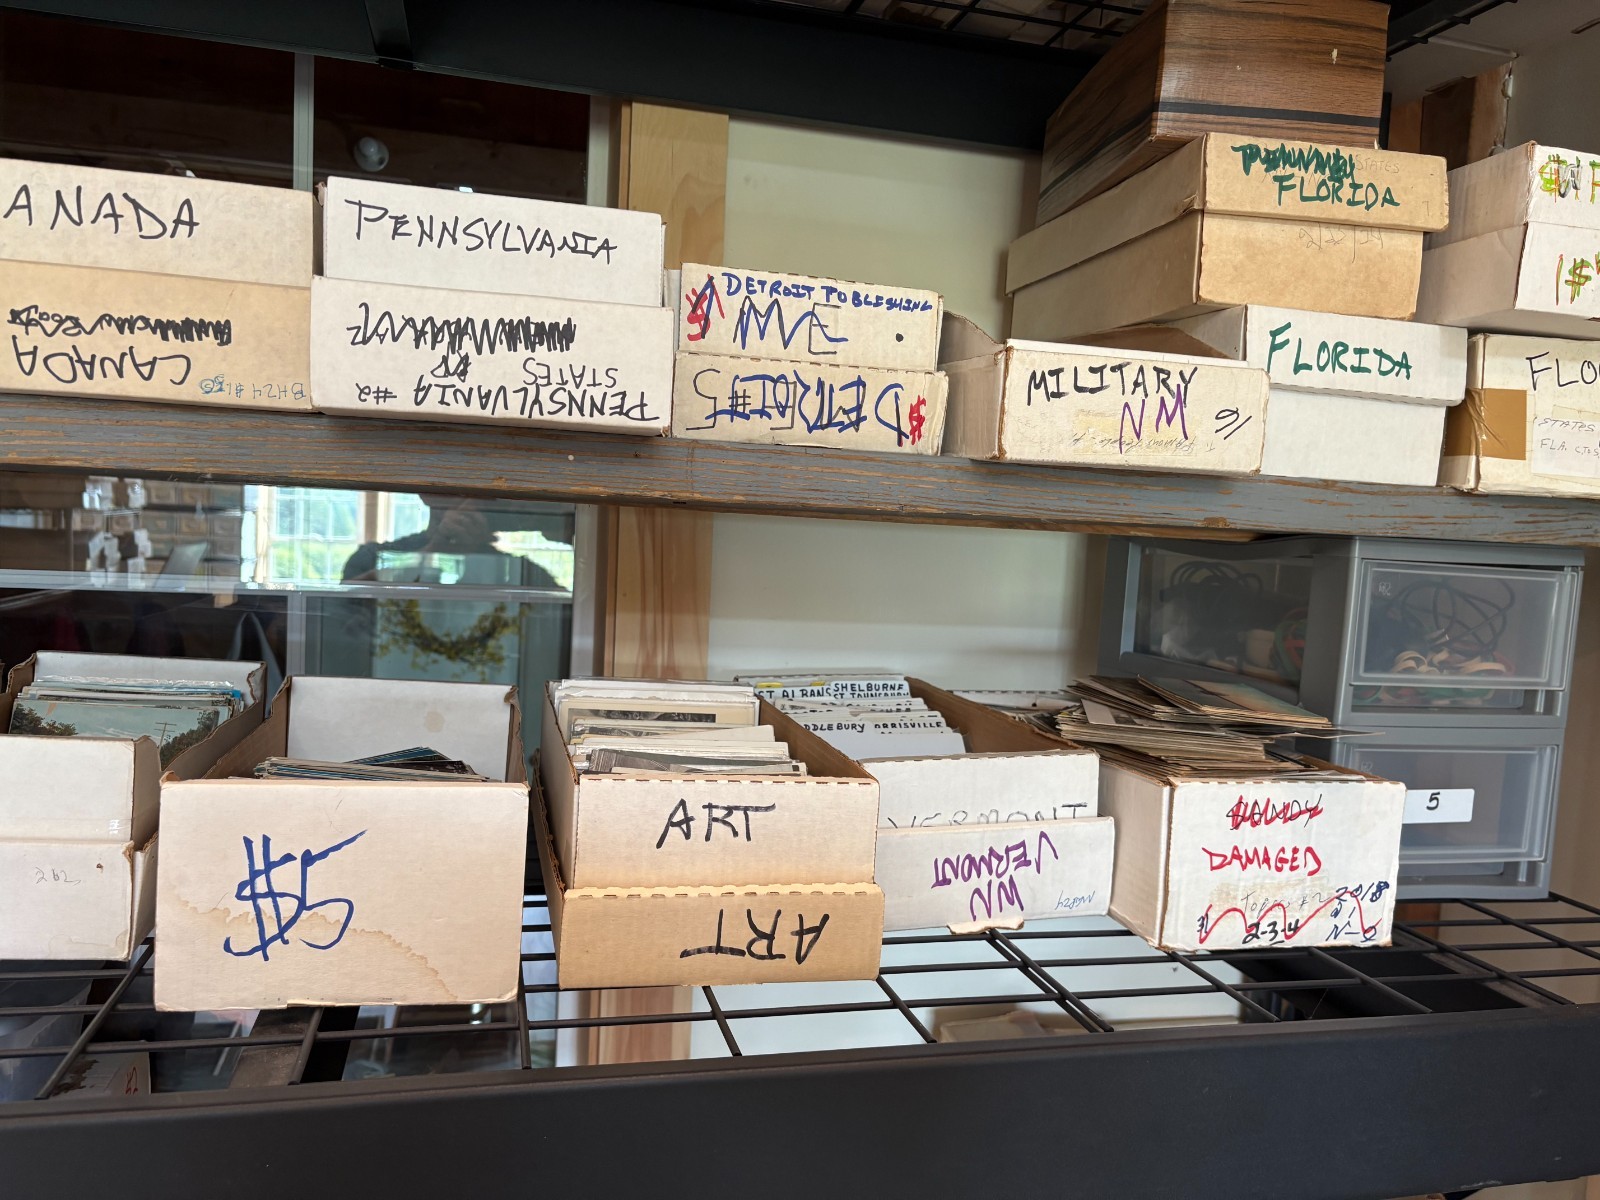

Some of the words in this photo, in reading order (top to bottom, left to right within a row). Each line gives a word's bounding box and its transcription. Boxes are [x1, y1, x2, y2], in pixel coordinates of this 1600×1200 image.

[3, 184, 200, 239] ANADA
[1272, 173, 1400, 212] FLORIDA
[345, 199, 617, 264] PENNSYLVANIA
[722, 272, 815, 301] DETROIT
[12, 335, 191, 386] CANADA
[522, 357, 618, 388] STATES
[1267, 322, 1412, 380] FLORIDA
[414, 375, 660, 421] PENNSYLVANIA
[1027, 361, 1198, 408] MILITARY
[832, 683, 905, 693] SHELBURNE
[655, 798, 776, 850] ART
[1426, 791, 1441, 811] 5
[931, 831, 1059, 889] VERMONT
[1201, 845, 1322, 876] DAMAGED
[680, 909, 830, 965] ART
